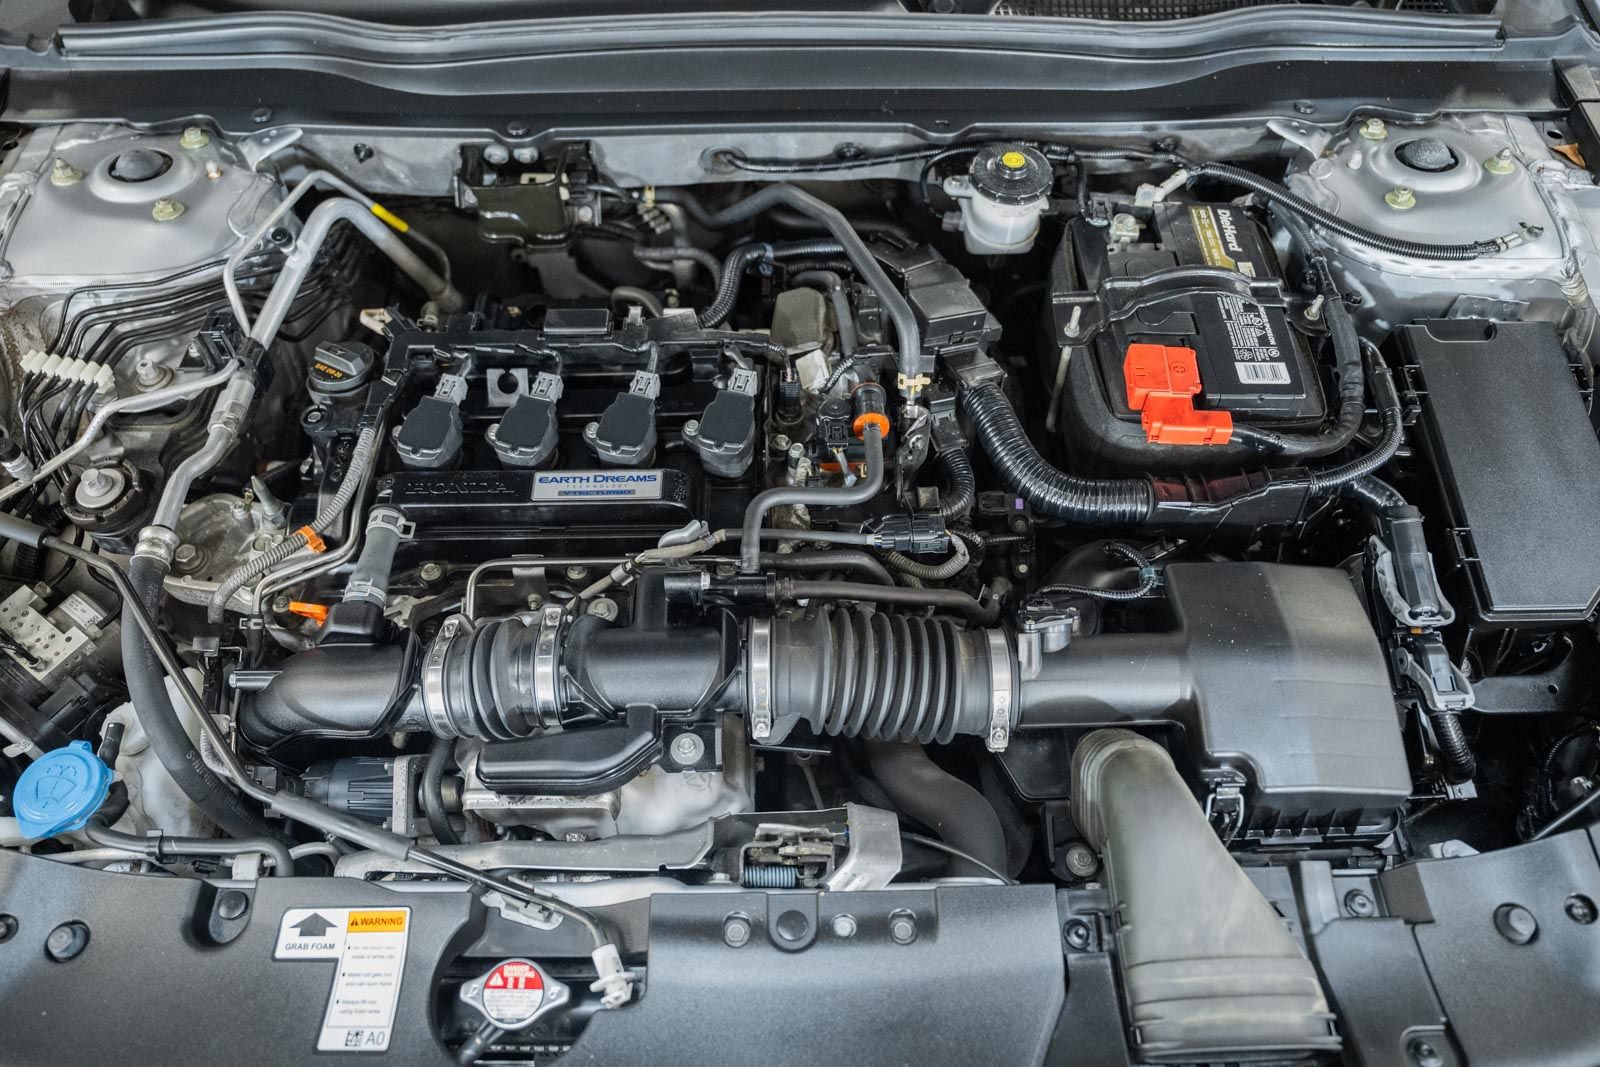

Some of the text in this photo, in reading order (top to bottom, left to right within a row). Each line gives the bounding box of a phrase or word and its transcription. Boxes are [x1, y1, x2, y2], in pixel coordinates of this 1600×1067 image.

[1217, 208, 1243, 252] DieHard
[538, 474, 657, 484] EARTH DREAMS
[405, 482, 515, 495] HONDA
[360, 917, 403, 926] WARNING
[365, 1031, 386, 1045] A0
